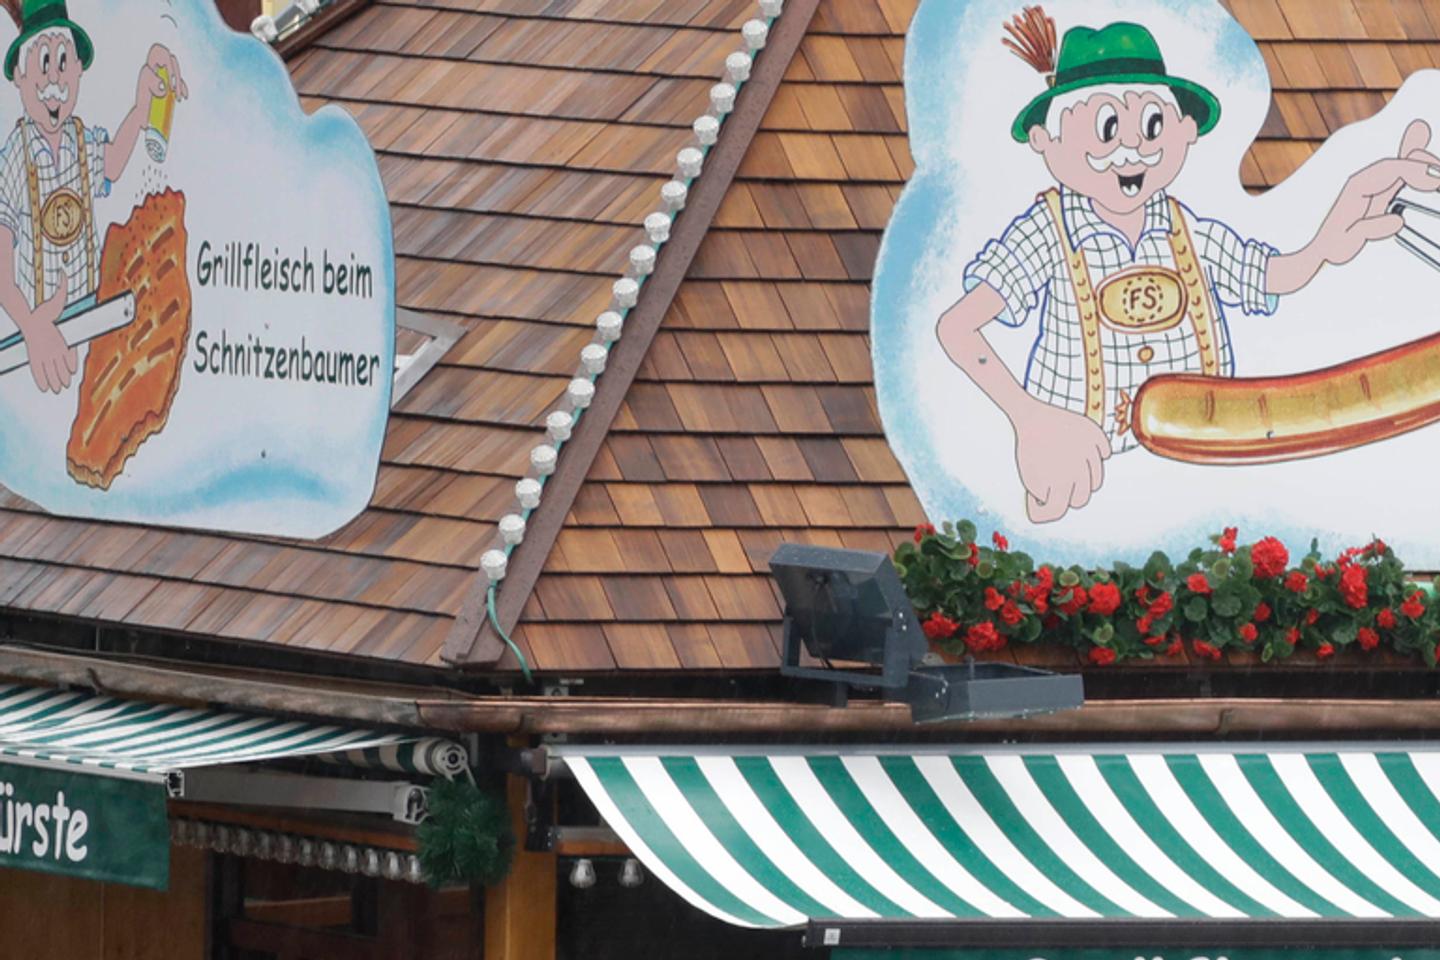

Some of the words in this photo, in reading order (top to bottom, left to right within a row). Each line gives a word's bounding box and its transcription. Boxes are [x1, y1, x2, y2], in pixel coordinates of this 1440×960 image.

[196, 240, 315, 294] Grillfleisch
[322, 249, 373, 299] beim
[1130, 285, 1157, 310] FS
[193, 329, 380, 387] Schnitzenbaumer
